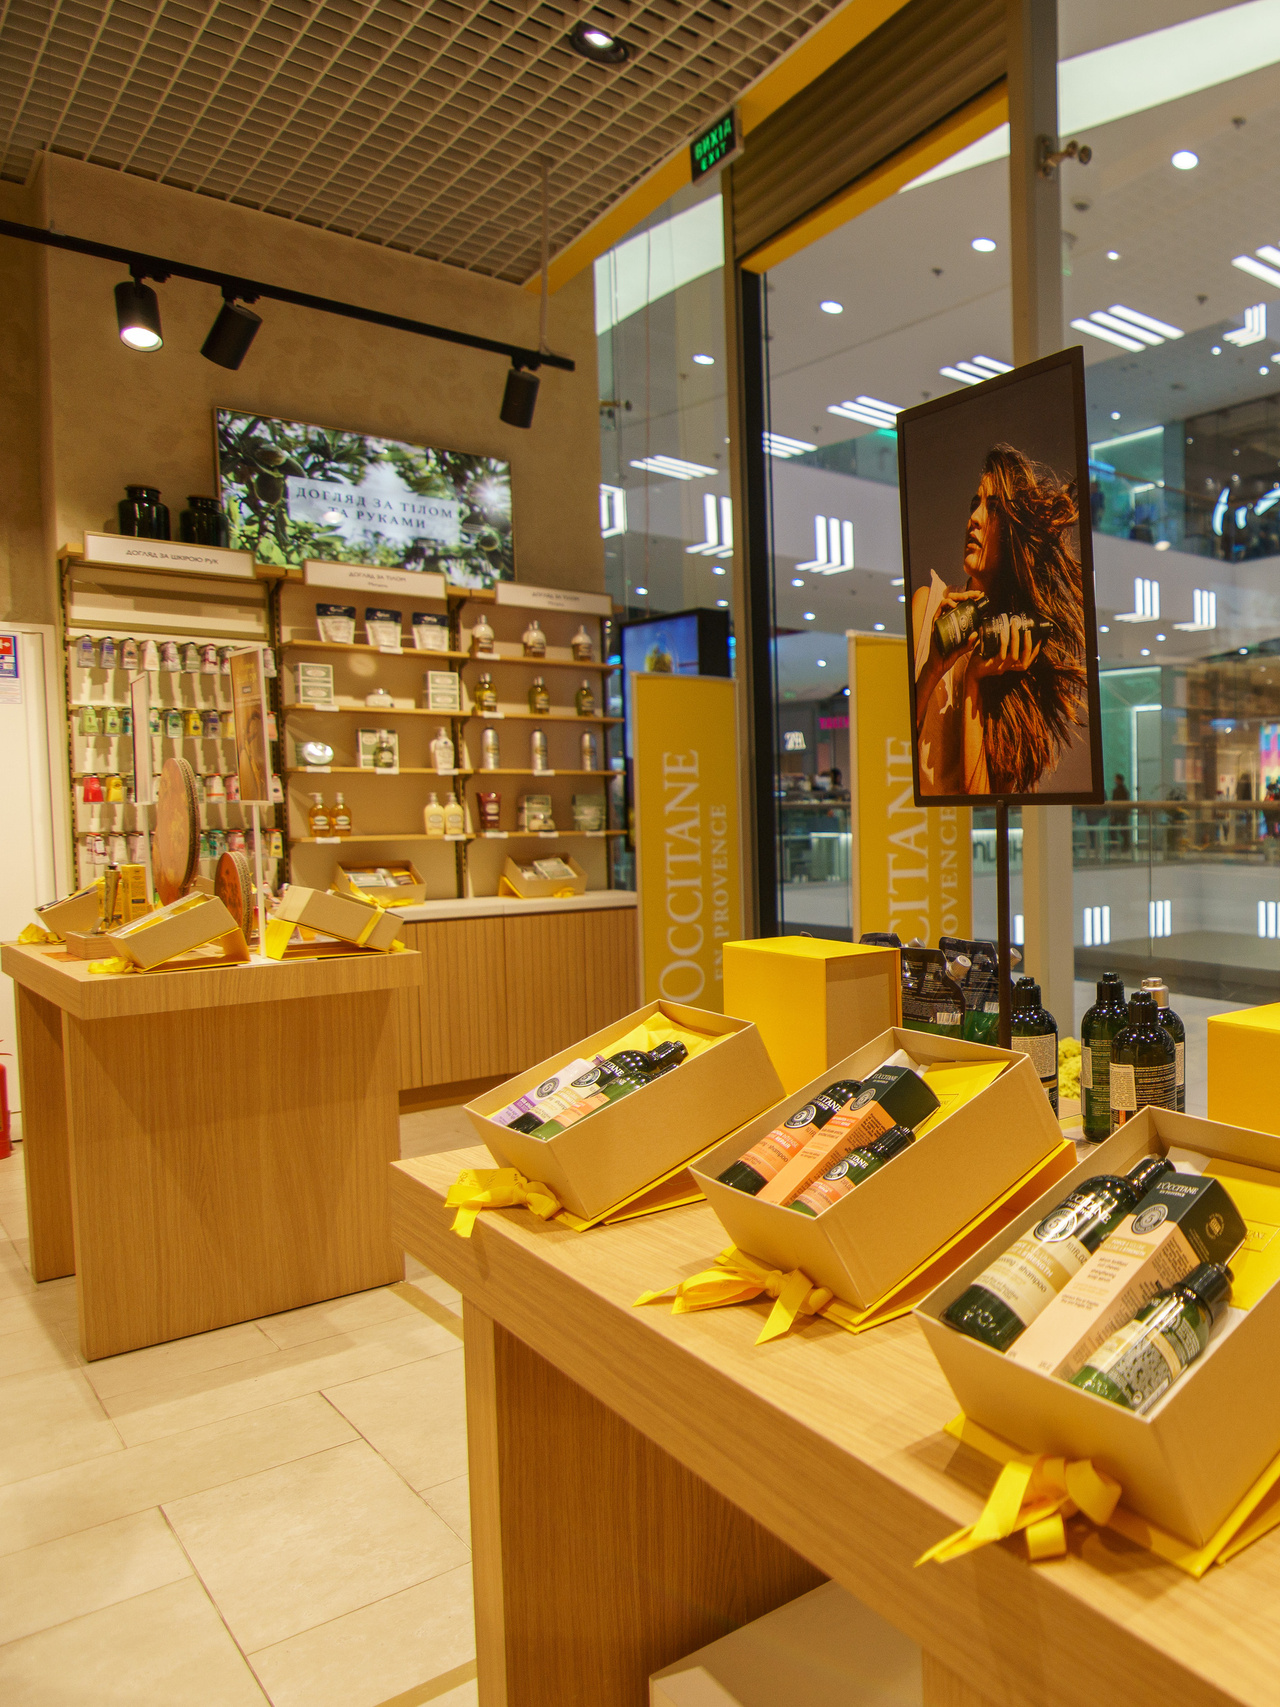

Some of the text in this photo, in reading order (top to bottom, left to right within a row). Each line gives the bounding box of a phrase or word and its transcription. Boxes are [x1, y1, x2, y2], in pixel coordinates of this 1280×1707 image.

[695, 117, 732, 160] ВИХІД
[701, 141, 726, 171] EXIT
[296, 487, 453, 518] ДОГЛЯД ЗА ТІЛОМ
[357, 510, 426, 529] РУКАМИ
[126, 549, 158, 558] ДОГЛЯД
[711, 803, 730, 939] PROVENCE
[768, 1144, 789, 1163] shampoo
[1156, 1181, 1199, 1195] L'OCCITANE
[1021, 1250, 1054, 1278] STRENGTH
[1019, 1264, 1048, 1293] shampoo
